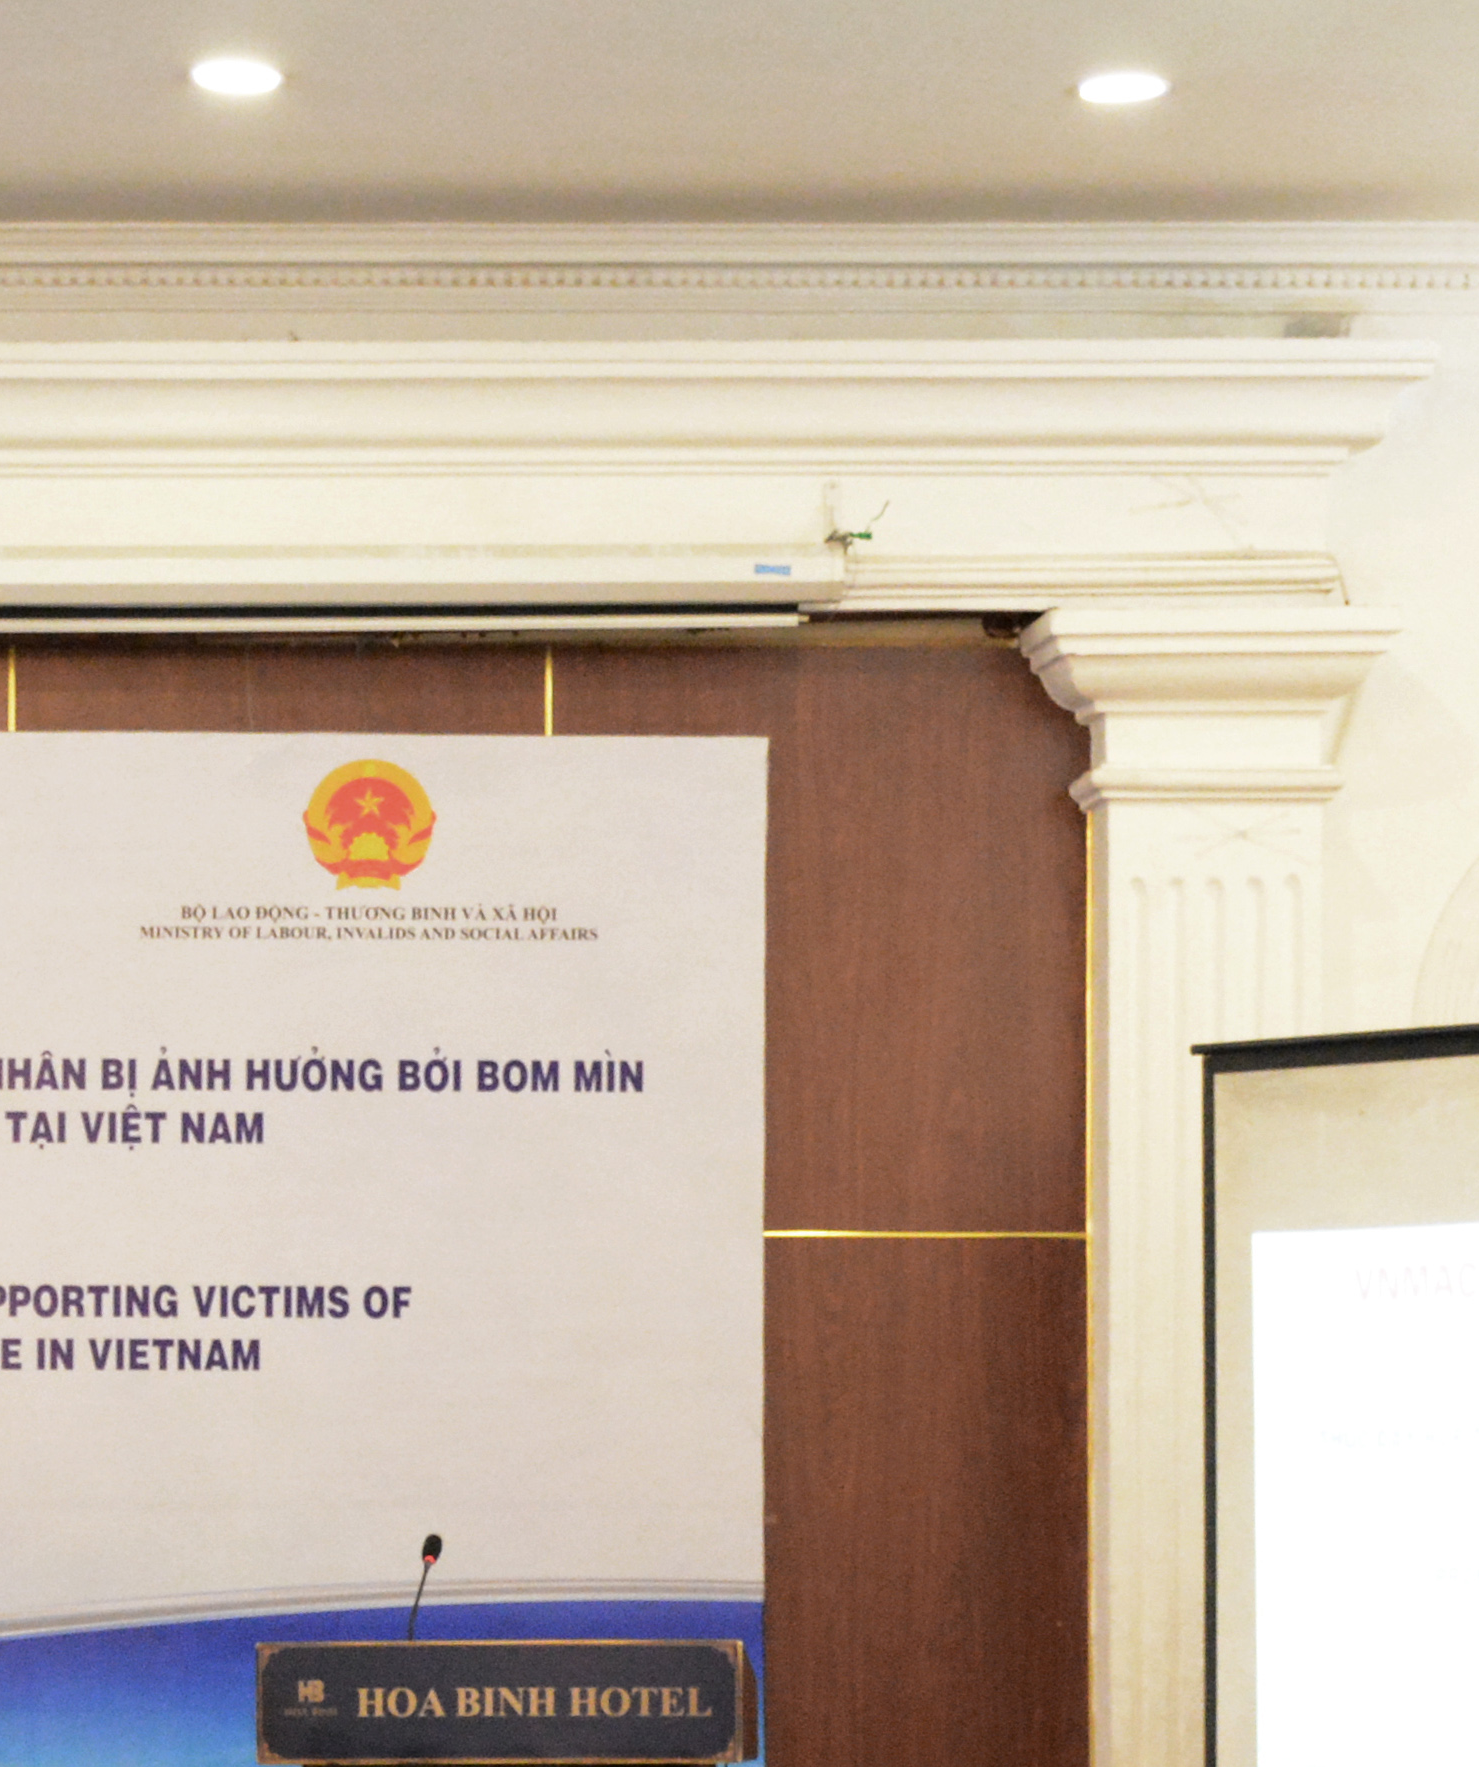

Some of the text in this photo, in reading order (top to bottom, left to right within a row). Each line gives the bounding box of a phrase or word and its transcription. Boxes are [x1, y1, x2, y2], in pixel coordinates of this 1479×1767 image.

[181, 905, 206, 922] BỘ
[212, 905, 249, 922] LAO
[255, 905, 309, 922] ĐỘNG
[326, 905, 405, 922] THƯƠNG
[411, 906, 456, 923] BINH
[462, 906, 487, 923] VÀ
[492, 906, 517, 923] XÃ
[523, 906, 558, 923] HỘI
[140, 925, 598, 941] MINISTRY OF LABOUR, INVALIDS AND SOCIAL AFFAIRS
[100, 1058, 137, 1098] BỊ
[151, 1046, 231, 1091] ẢNH
[245, 1046, 383, 1093] HƯỞNG
[397, 1046, 462, 1093] BỞI
[476, 1059, 560, 1093] BOM
[573, 1049, 644, 1093] MÌN
[5, 1110, 66, 1150] TẠI
[80, 1103, 167, 1151] VIỆT
[180, 1111, 264, 1144] NAM
[192, 1284, 350, 1319] VICTIMS
[362, 1284, 412, 1320] OF
[36, 1338, 74, 1371] IN
[88, 1338, 261, 1371] VIETNAM
[298, 1679, 325, 1702] HB
[358, 1686, 711, 1718] HOA BINH HOTEL
